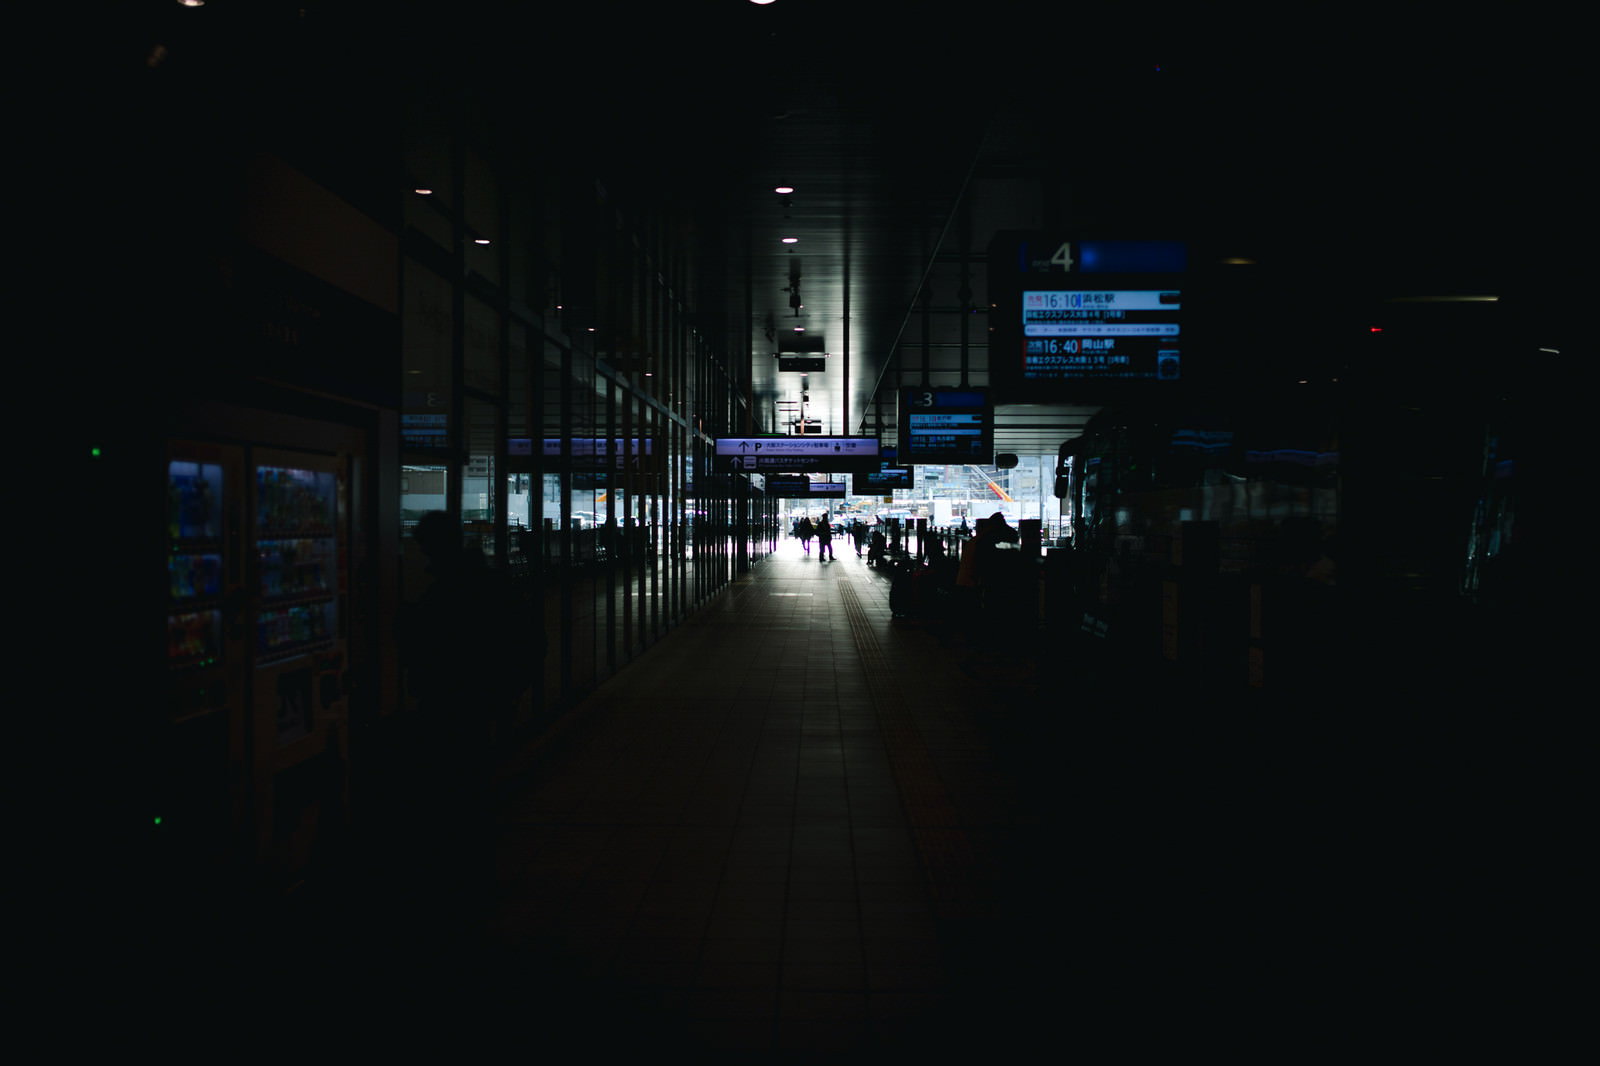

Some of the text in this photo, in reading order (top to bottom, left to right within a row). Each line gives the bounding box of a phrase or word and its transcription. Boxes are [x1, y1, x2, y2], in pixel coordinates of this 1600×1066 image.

[1050, 242, 1074, 272] 4
[1044, 293, 1077, 308] 16:10
[1082, 293, 1115, 304] 浜松駅
[1043, 339, 1078, 354] 16:40
[1082, 338, 1115, 349] 岡山駅
[922, 392, 934, 408] 3
[755, 442, 762, 452] P
